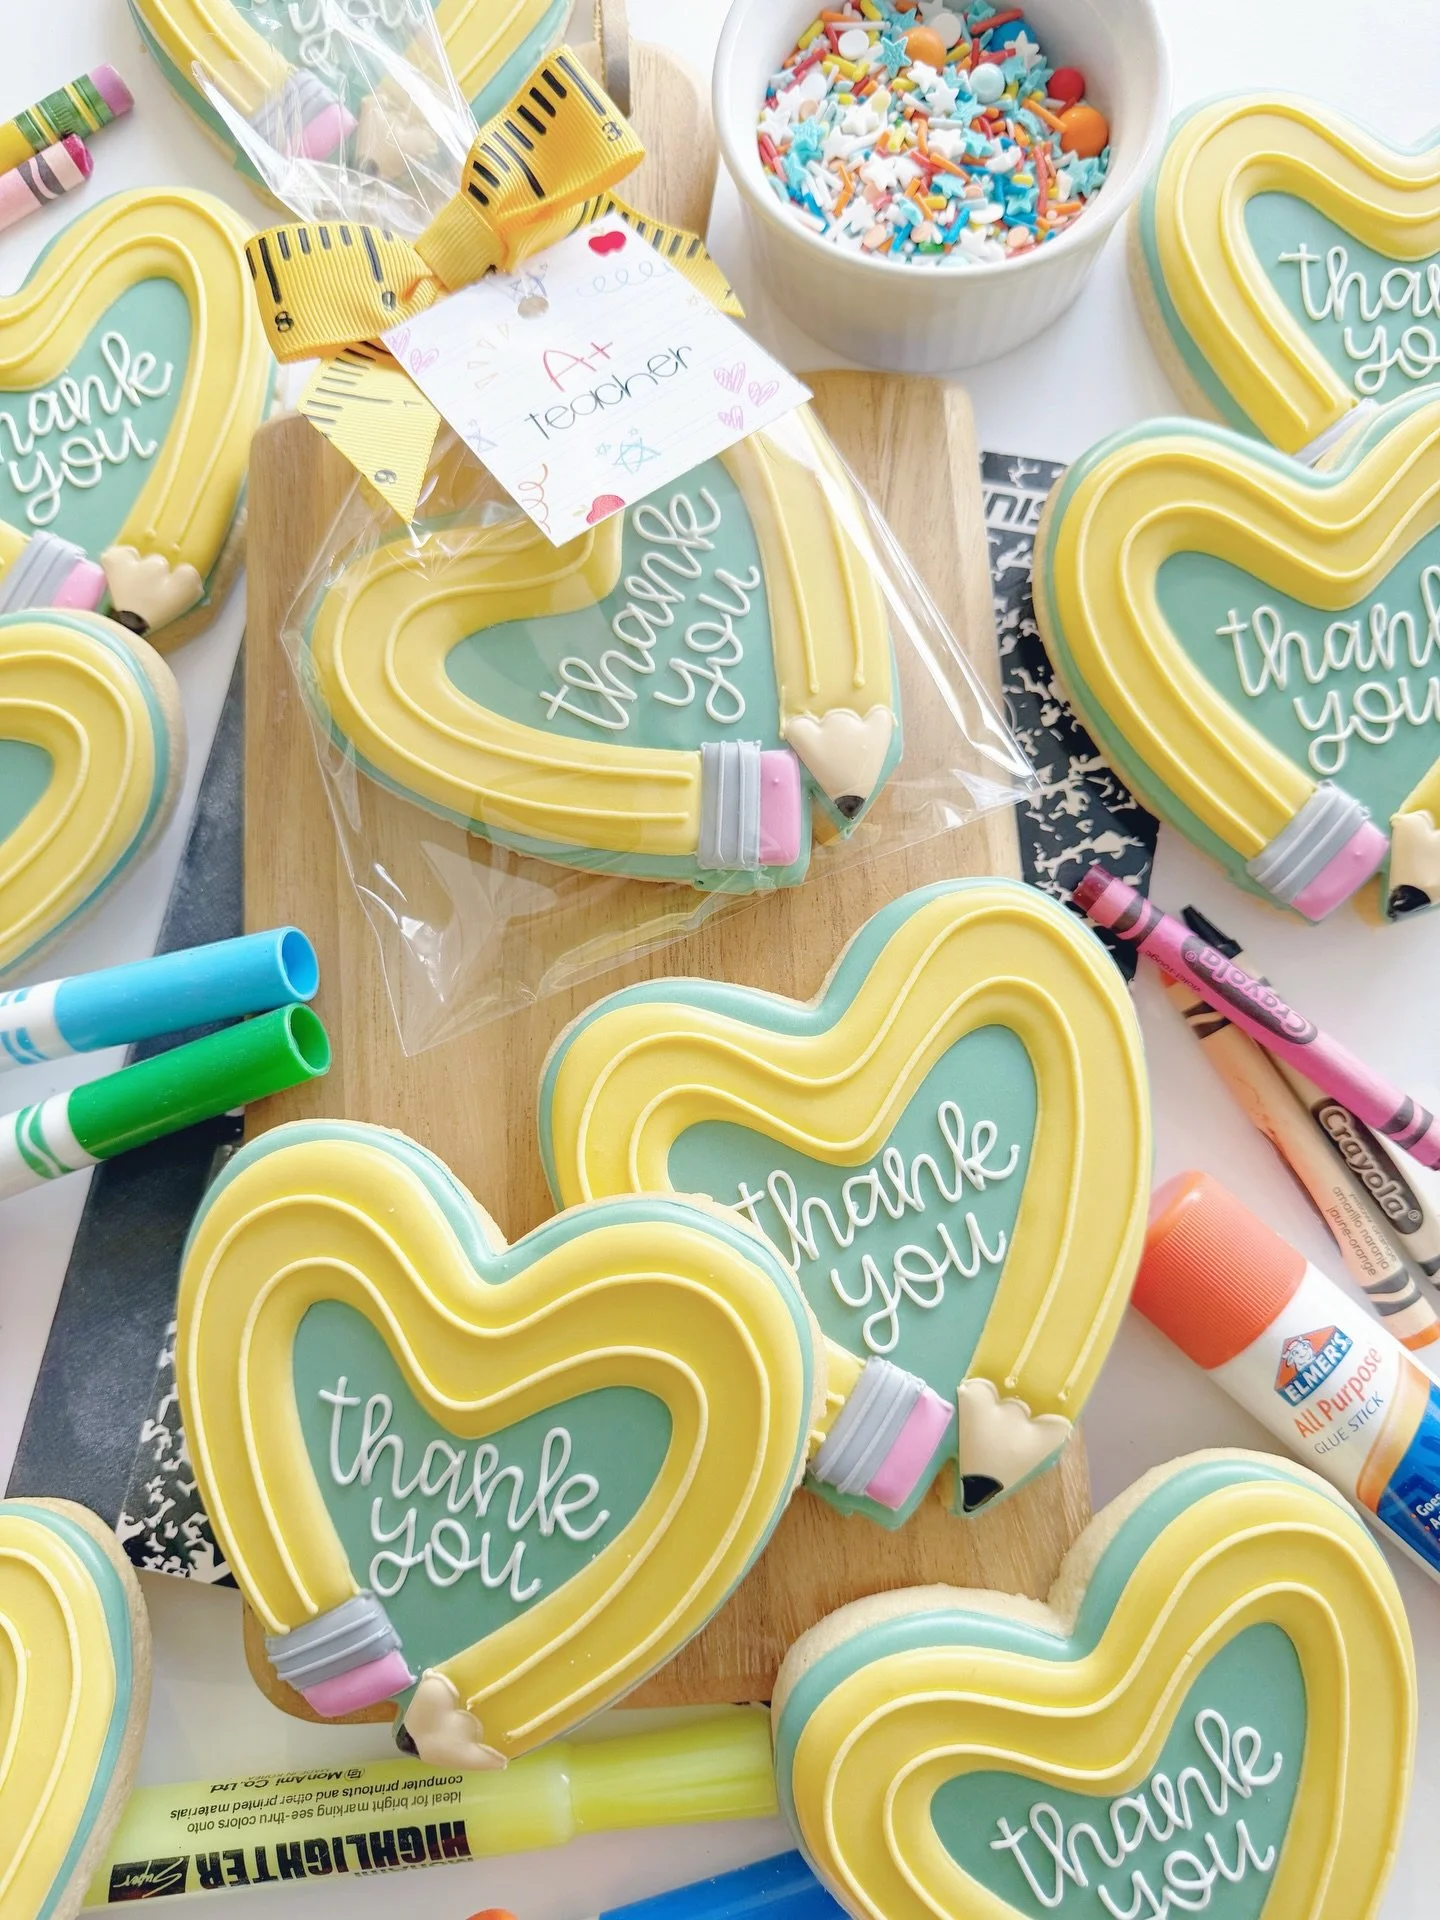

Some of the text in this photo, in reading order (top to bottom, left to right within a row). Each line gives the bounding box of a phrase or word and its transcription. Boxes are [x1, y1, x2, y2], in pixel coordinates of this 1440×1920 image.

[524, 345, 692, 440] teacher
[543, 341, 613, 392] A+
[8, 418, 158, 526] you
[539, 486, 722, 730] thank
[653, 565, 761, 724] you
[1293, 676, 1440, 776] you
[1200, 947, 1310, 1038] Crayola
[728, 1100, 1020, 1272] thank
[1318, 1105, 1406, 1221] Crayola
[1327, 1206, 1377, 1277] jaune-orange
[1332, 1186, 1390, 1270] amarillo naranja
[830, 1212, 1007, 1354] you
[1284, 1332, 1350, 1402] ELMER'S
[1294, 1347, 1382, 1438] All Purpose
[318, 1376, 611, 1540] thank
[1313, 1391, 1384, 1455] GLUE STICK
[369, 1497, 542, 1602] you
[170, 1775, 463, 1820] computer printouts and other printed materials
[187, 1791, 462, 1834] Ideal for bright marking see-thru colors onto
[989, 1708, 1283, 1907] thank
[113, 1820, 472, 1899] HIGHLIGHTER Super
[1098, 1819, 1276, 1920] you
